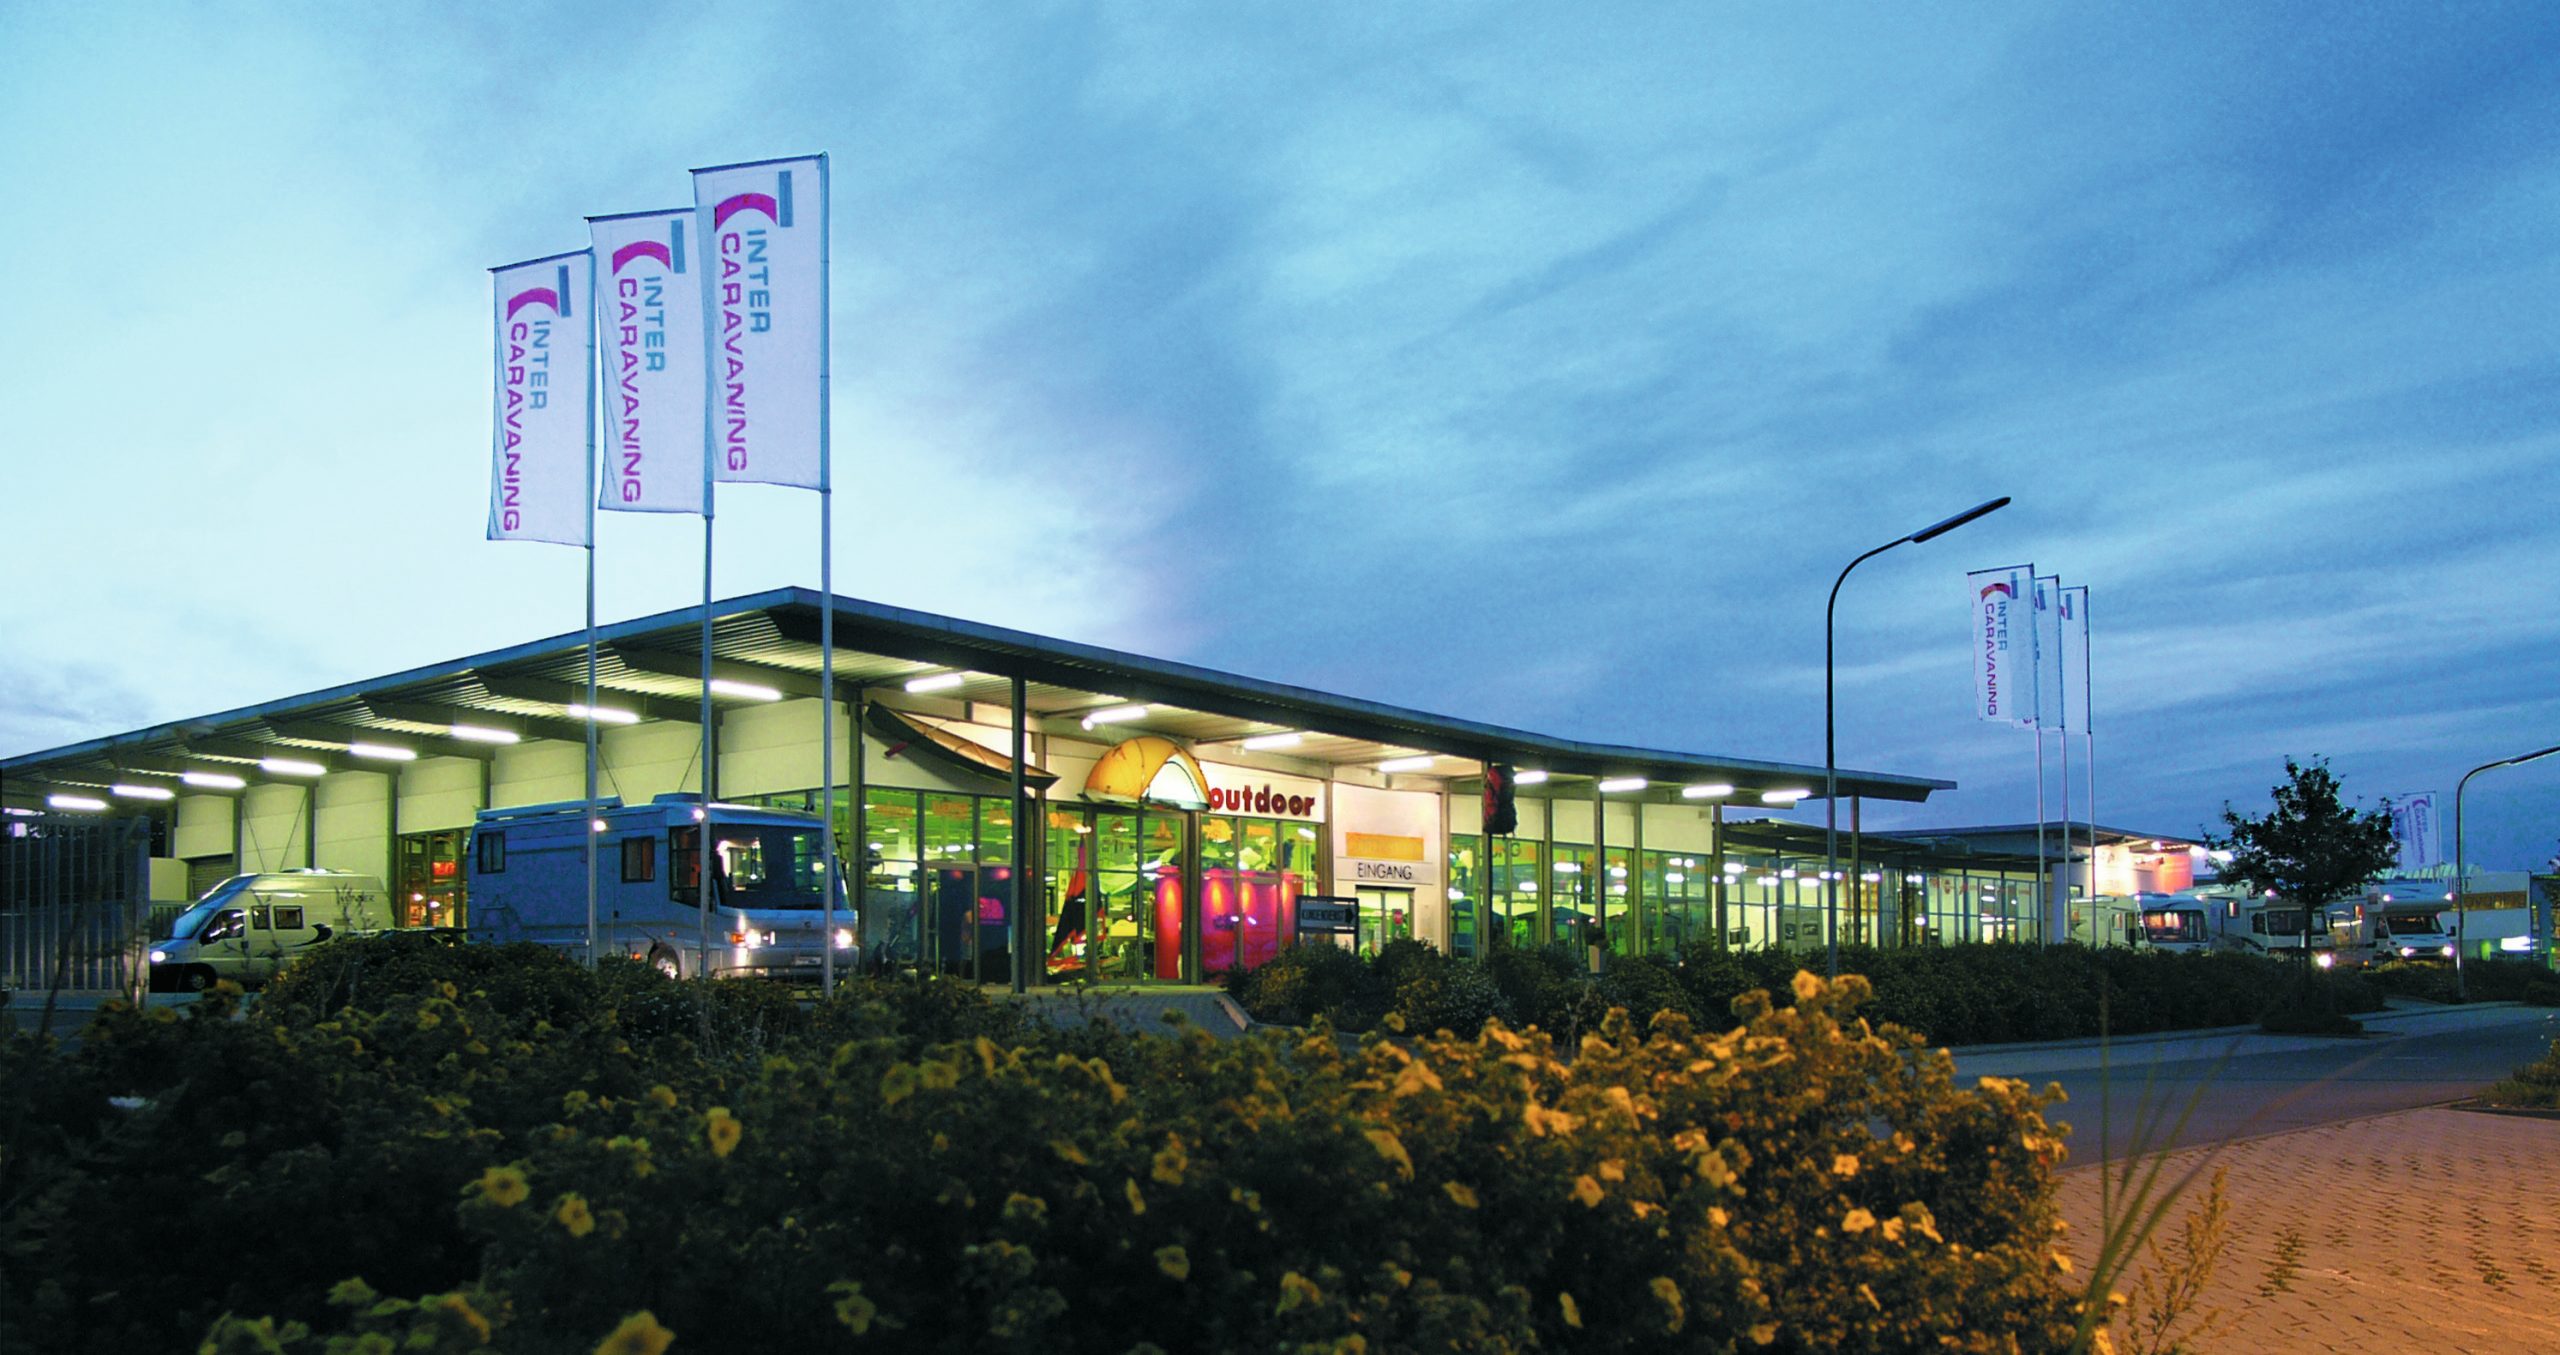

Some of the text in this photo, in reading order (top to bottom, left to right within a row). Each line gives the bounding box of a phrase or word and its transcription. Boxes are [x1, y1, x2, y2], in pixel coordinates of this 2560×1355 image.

[643, 276, 665, 373] INTER
[746, 229, 771, 333] INTER
[529, 320, 551, 410] INTER
[619, 279, 642, 502] CARAVANING
[720, 232, 747, 471] CARAVANING
[503, 323, 528, 531] CARAVANING
[1985, 603, 1997, 716] CARAVANING
[1997, 602, 2007, 650] INTER
[1210, 784, 1315, 816] outdoor
[1357, 862, 1413, 880] EINGANG
